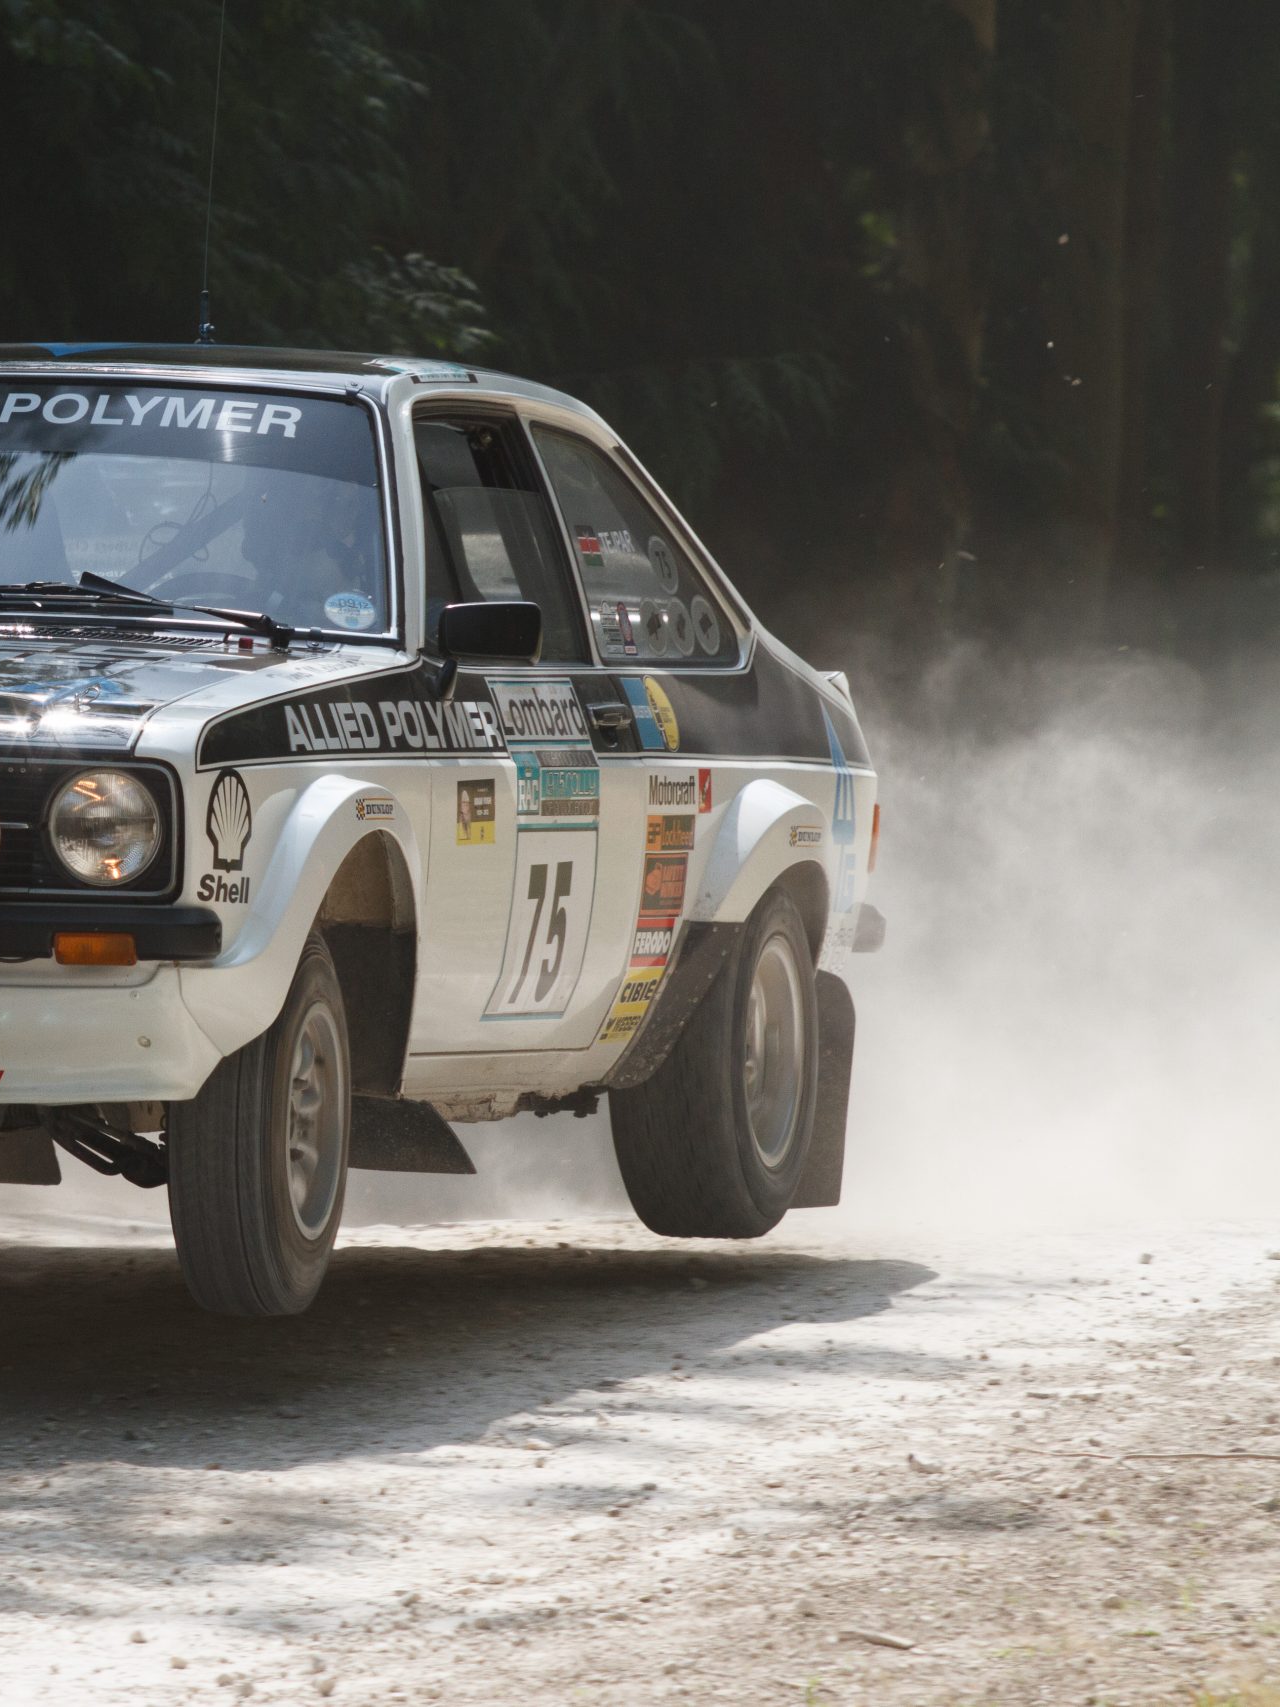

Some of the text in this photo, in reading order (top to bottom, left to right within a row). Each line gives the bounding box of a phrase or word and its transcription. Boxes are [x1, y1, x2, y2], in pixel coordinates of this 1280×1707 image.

[283, 700, 505, 752] ALLIED POLYMER
[490, 686, 588, 737] Lombard
[648, 774, 696, 806] Motorcraft
[365, 803, 394, 816] DUNLOP
[196, 873, 250, 904] Shell
[507, 860, 574, 1006] 75
[633, 930, 671, 956] FERODO
